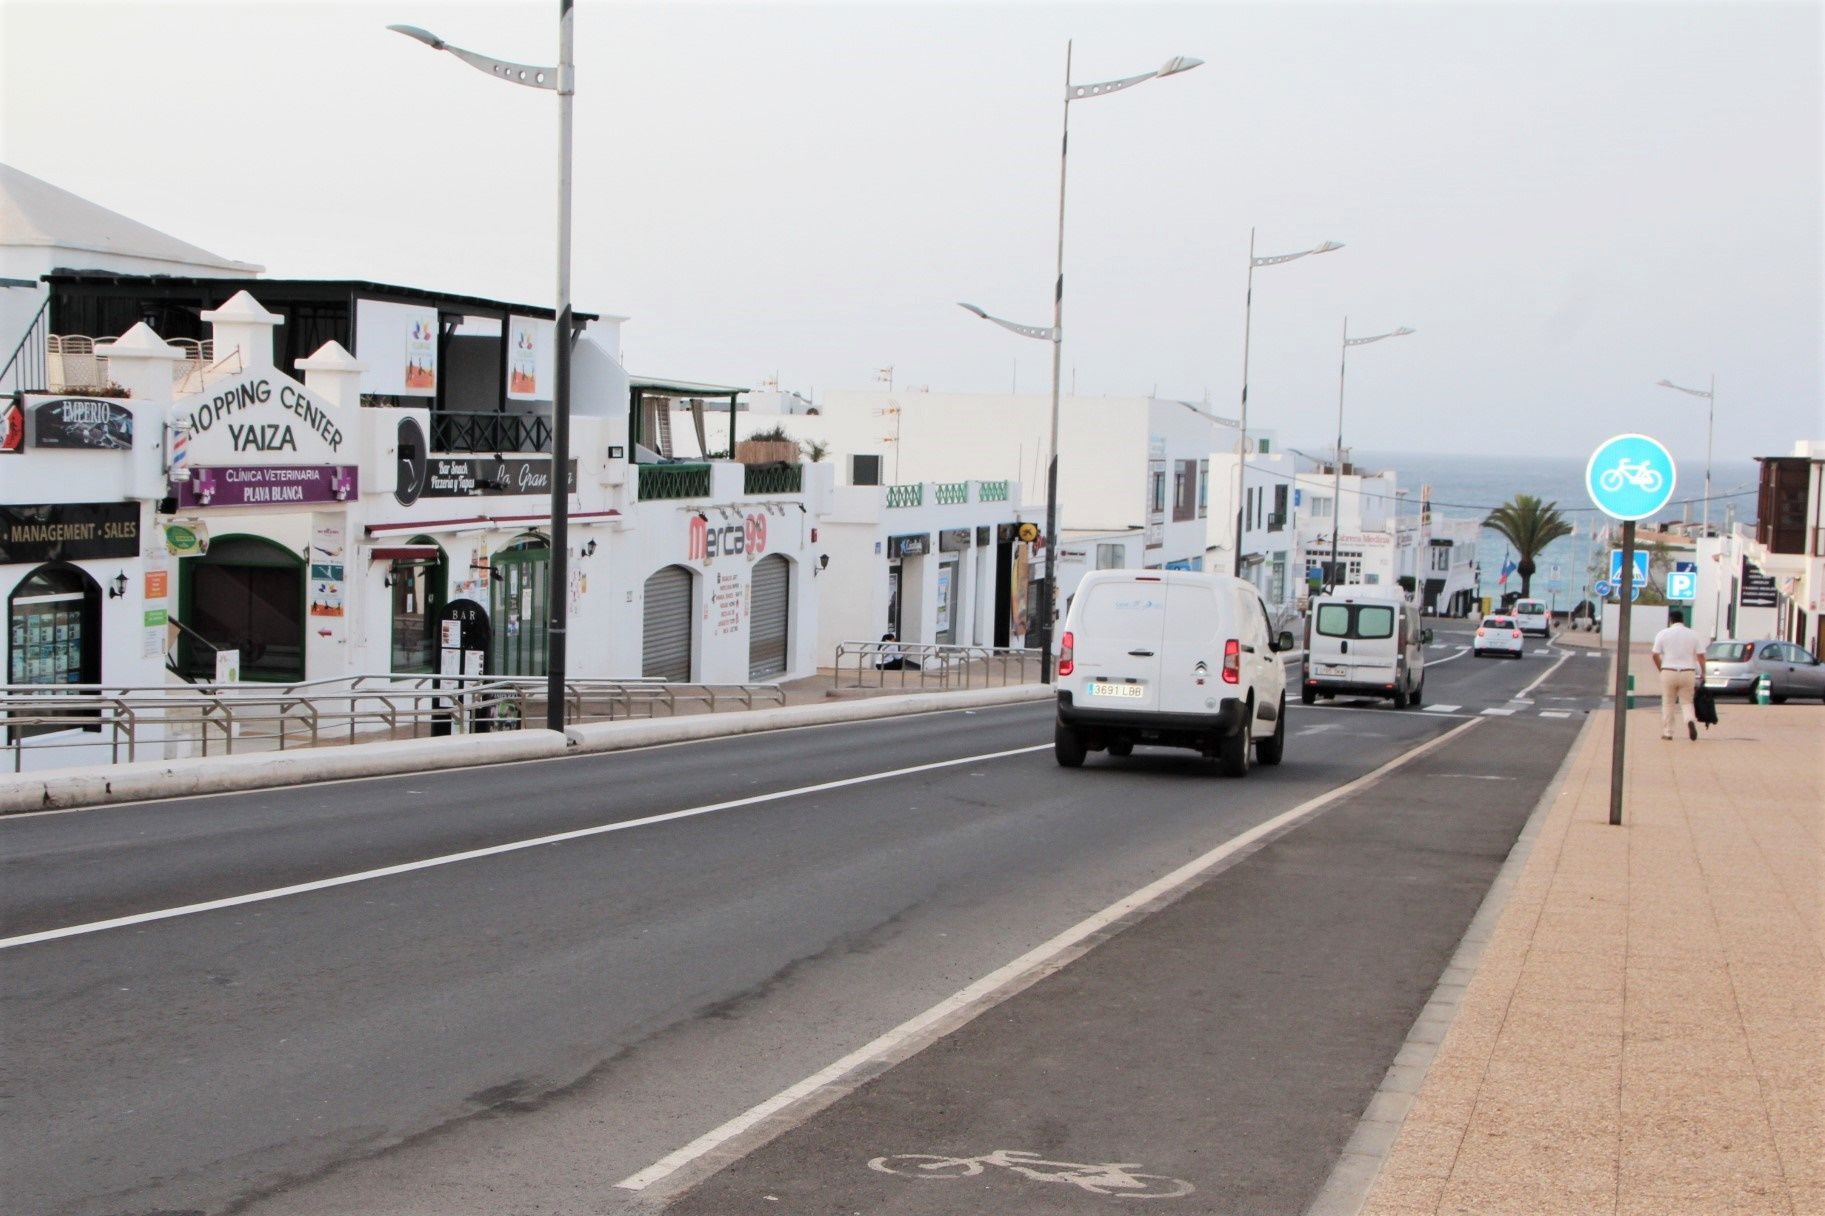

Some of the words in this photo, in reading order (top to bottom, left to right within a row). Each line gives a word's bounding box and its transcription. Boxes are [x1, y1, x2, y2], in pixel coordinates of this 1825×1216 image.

[62, 400, 111, 423] IMPERIO
[188, 379, 272, 441] HOPPING
[280, 386, 343, 453] CENTER
[227, 424, 298, 452] YAIZA
[264, 469, 320, 481] VETERINARIA
[438, 460, 450, 475] Bar
[450, 460, 468, 475] Snack
[518, 463, 548, 492] Gran
[243, 486, 270, 502] PLAYA
[271, 485, 304, 501] BLANCA
[453, 478, 459, 493] y
[458, 474, 475, 493] Tapas
[11, 523, 96, 543] MANAGEMENT
[104, 521, 137, 539] SALES
[1672, 574, 1691, 597] P
[452, 610, 476, 621] BAR
[1094, 684, 1119, 695] 3691
